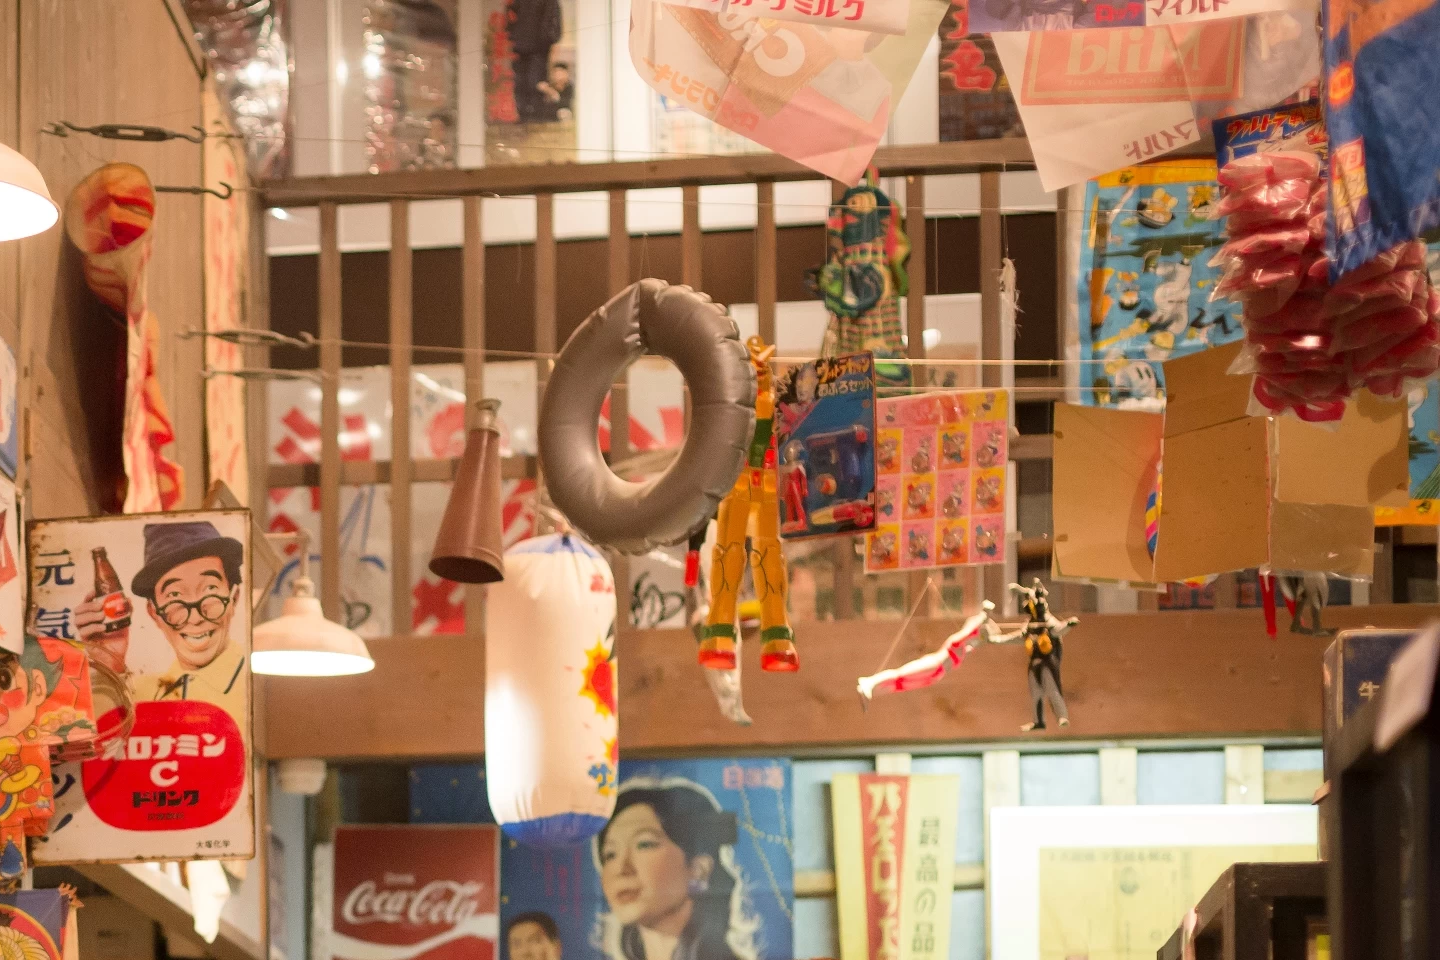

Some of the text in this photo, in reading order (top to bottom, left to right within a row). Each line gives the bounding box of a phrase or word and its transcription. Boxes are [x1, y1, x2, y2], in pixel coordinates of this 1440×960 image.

[101, 733, 227, 761] オロナミン
[150, 760, 180, 787] C
[132, 790, 200, 808] ドリンク
[342, 880, 486, 925] Coca-Cola
